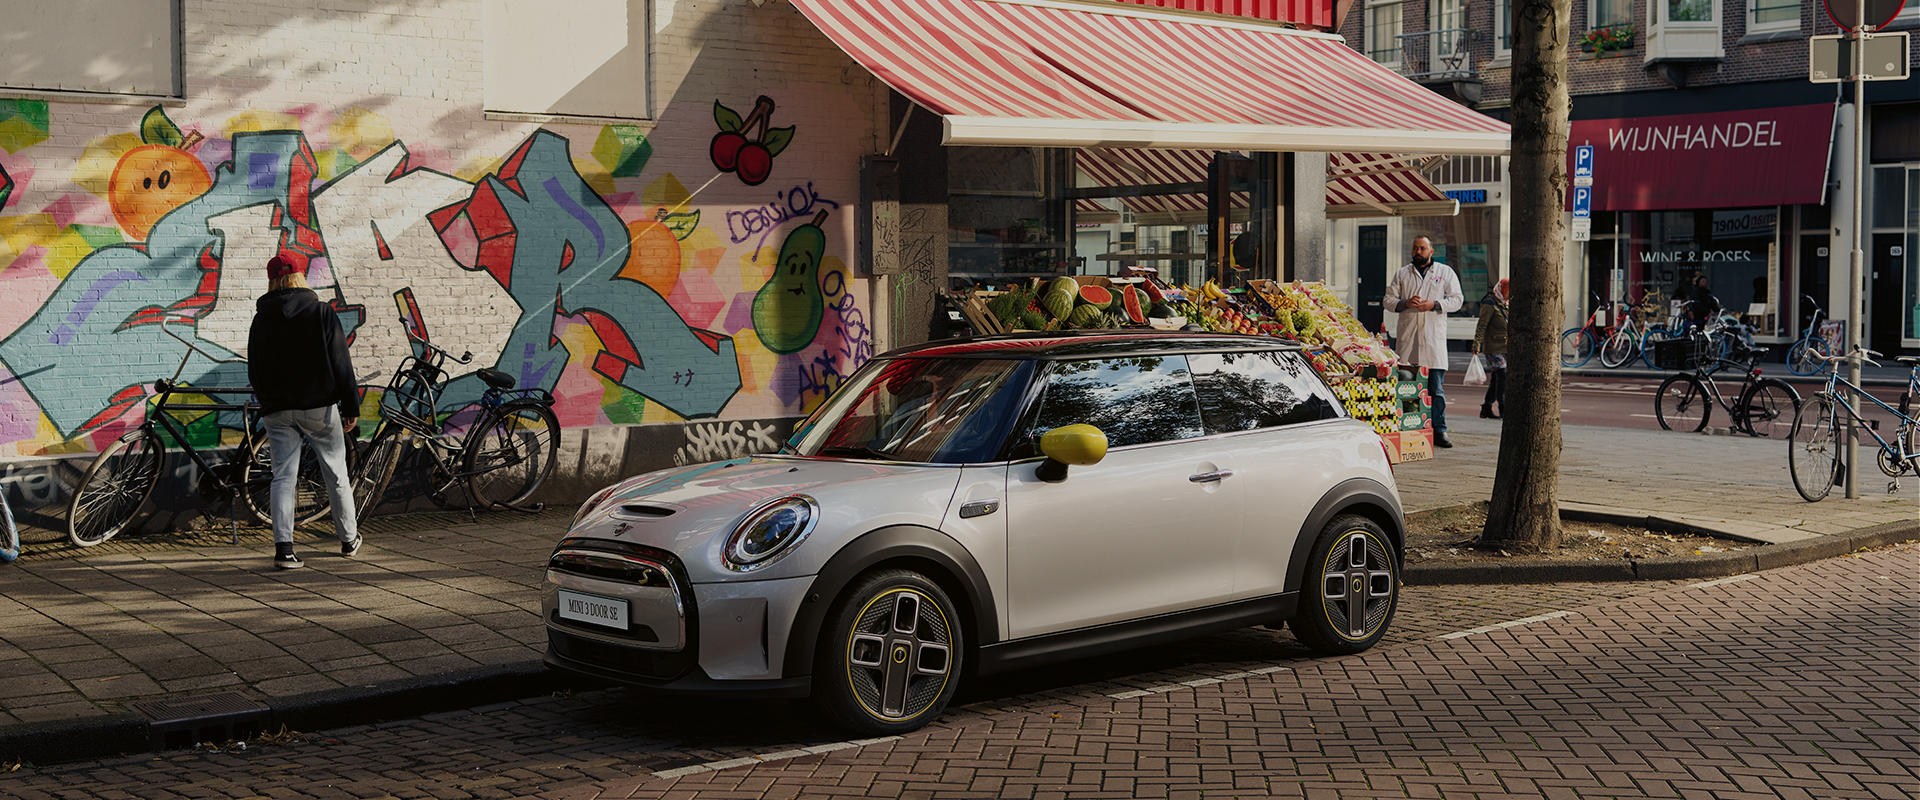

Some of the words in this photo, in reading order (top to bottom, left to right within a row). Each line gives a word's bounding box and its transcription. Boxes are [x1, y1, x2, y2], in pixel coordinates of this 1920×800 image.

[1609, 120, 1781, 151] WIJNHANDEL
[1579, 148, 1589, 165] P
[1577, 189, 1587, 205] P
[568, 598, 584, 614] MINI
[585, 602, 589, 615] 3
[590, 603, 608, 619] DOOR
[610, 606, 618, 621] SE
